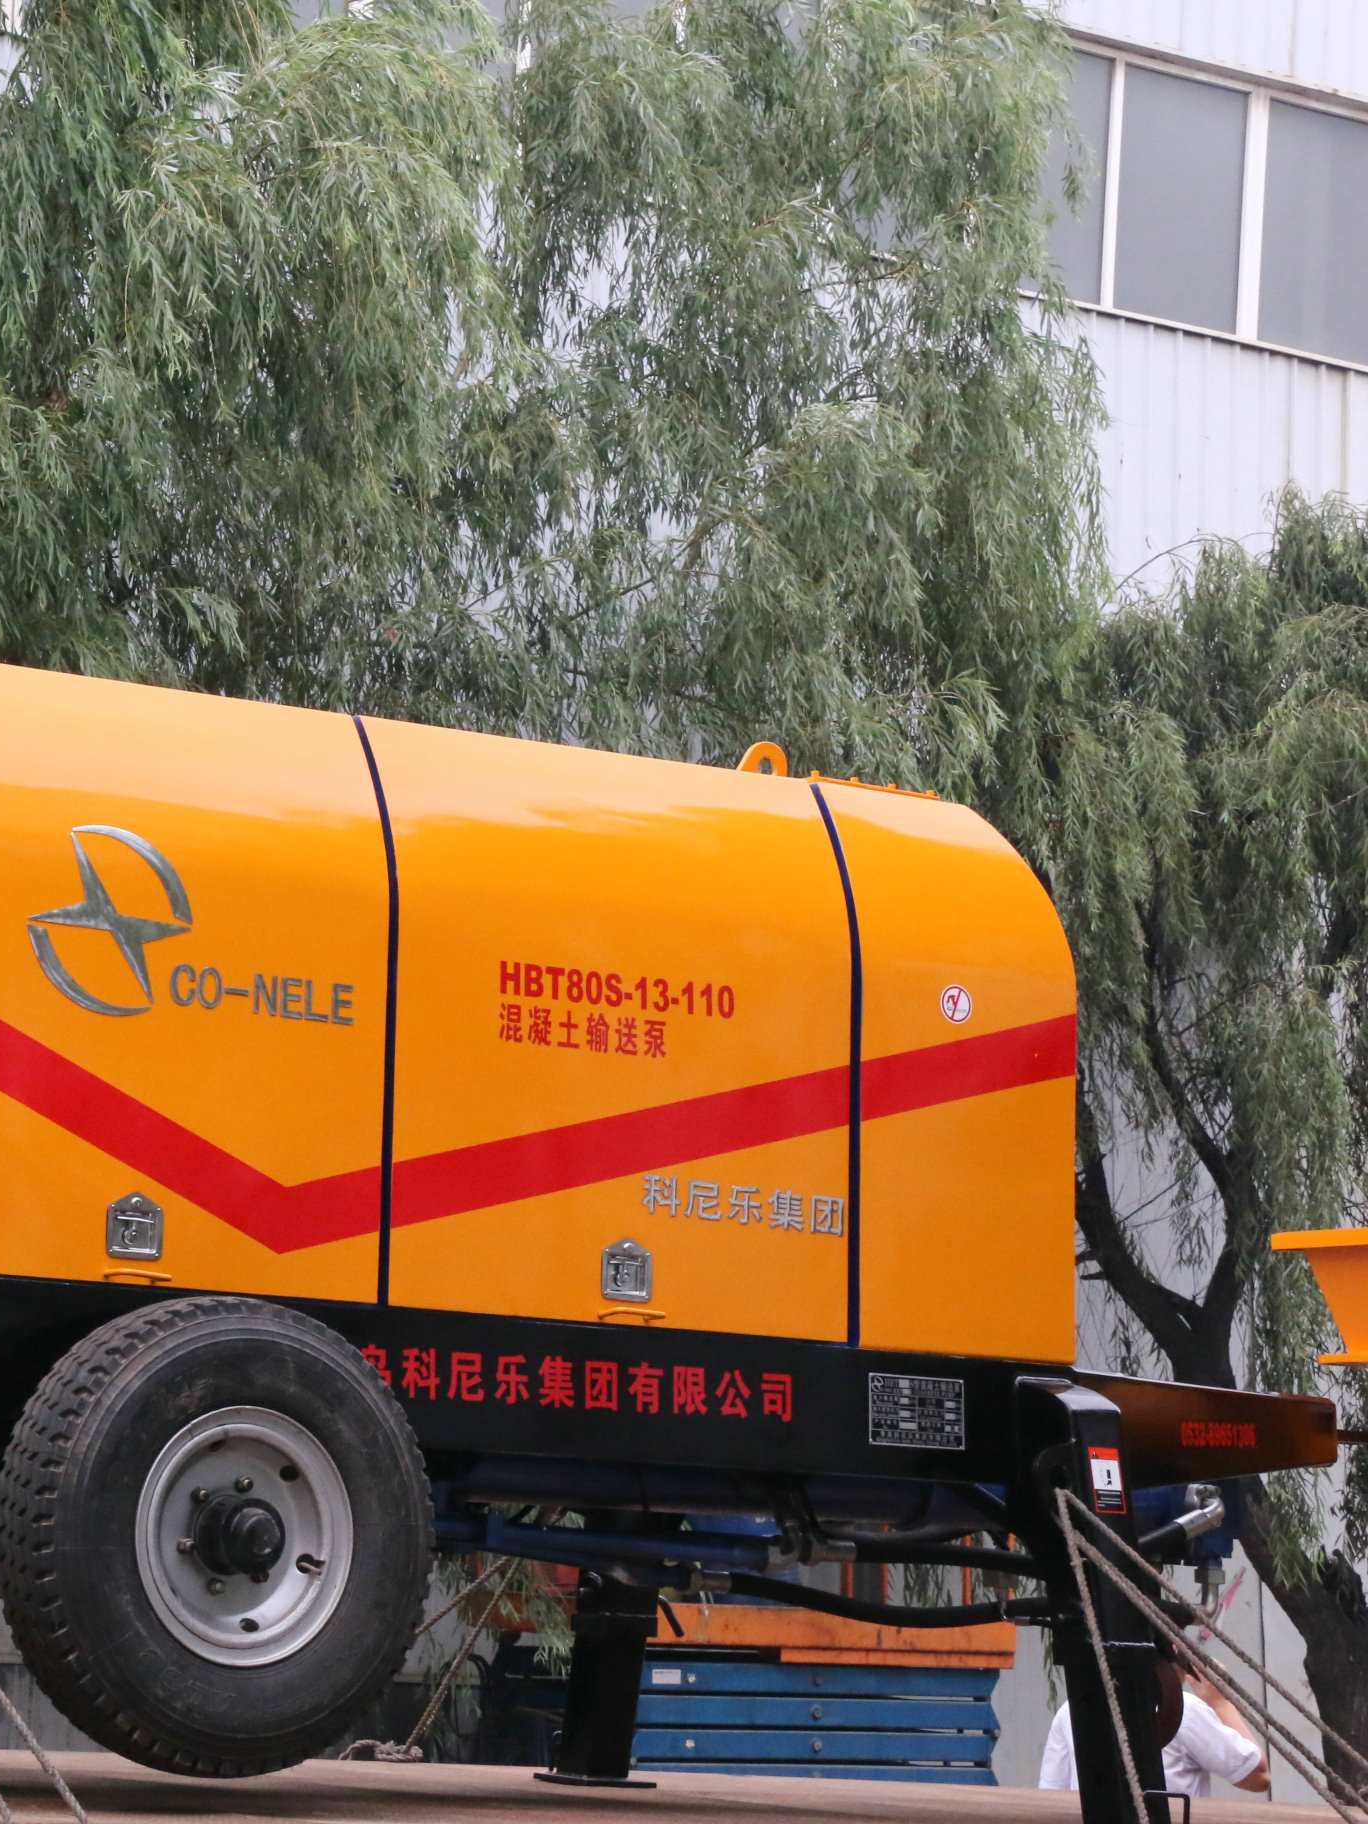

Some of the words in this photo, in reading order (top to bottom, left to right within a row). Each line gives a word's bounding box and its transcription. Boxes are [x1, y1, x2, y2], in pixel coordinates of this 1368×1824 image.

[169, 963, 355, 1026] CO-NELE
[499, 960, 735, 1019] HBT80S-13-110
[498, 1002, 668, 1059] 混凝土输送泵
[642, 1174, 845, 1236] 科尼乐集团
